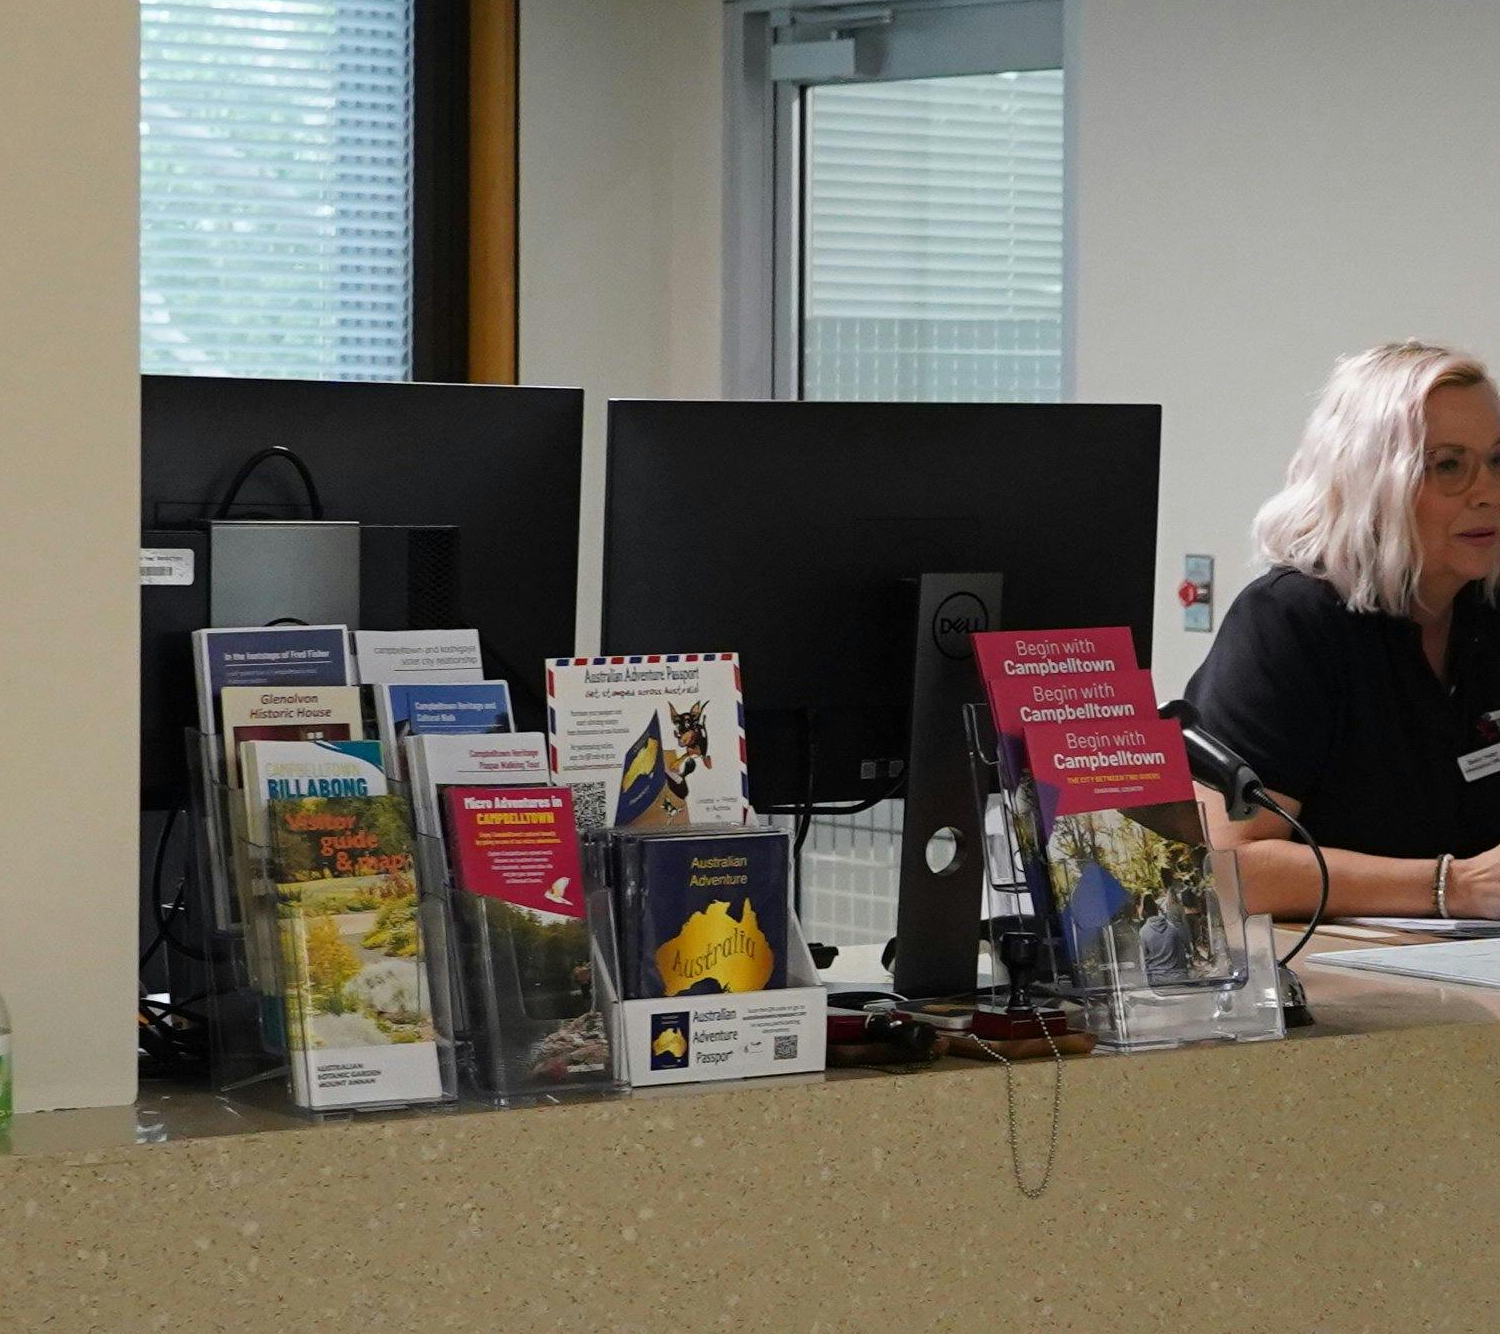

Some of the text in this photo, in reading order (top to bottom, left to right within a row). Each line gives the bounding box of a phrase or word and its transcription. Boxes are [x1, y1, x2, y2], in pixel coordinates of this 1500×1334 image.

[1015, 637, 1096, 660] Begin with
[584, 665, 700, 685] Australian Adventure Passport
[1003, 658, 1115, 677] Campbelltown
[260, 693, 319, 705] Glenalvon
[1032, 682, 1115, 705] Begin with
[249, 707, 332, 719] Historic House
[1019, 703, 1135, 724] Campbelltown
[1065, 730, 1146, 752] Begin with
[1052, 750, 1166, 771] Campbelltown
[267, 777, 368, 799] BILLABONG
[494, 796, 551, 809] Adventures
[551, 795, 563, 808] in
[475, 811, 555, 825] CAMPBELLTOWN
[320, 830, 379, 857] guide
[336, 850, 354, 873] &
[690, 854, 748, 869] Australian
[689, 873, 748, 888] Adventure
[672, 927, 756, 979] Australia
[692, 1007, 737, 1023] Australian
[692, 1029, 738, 1044] Adventure
